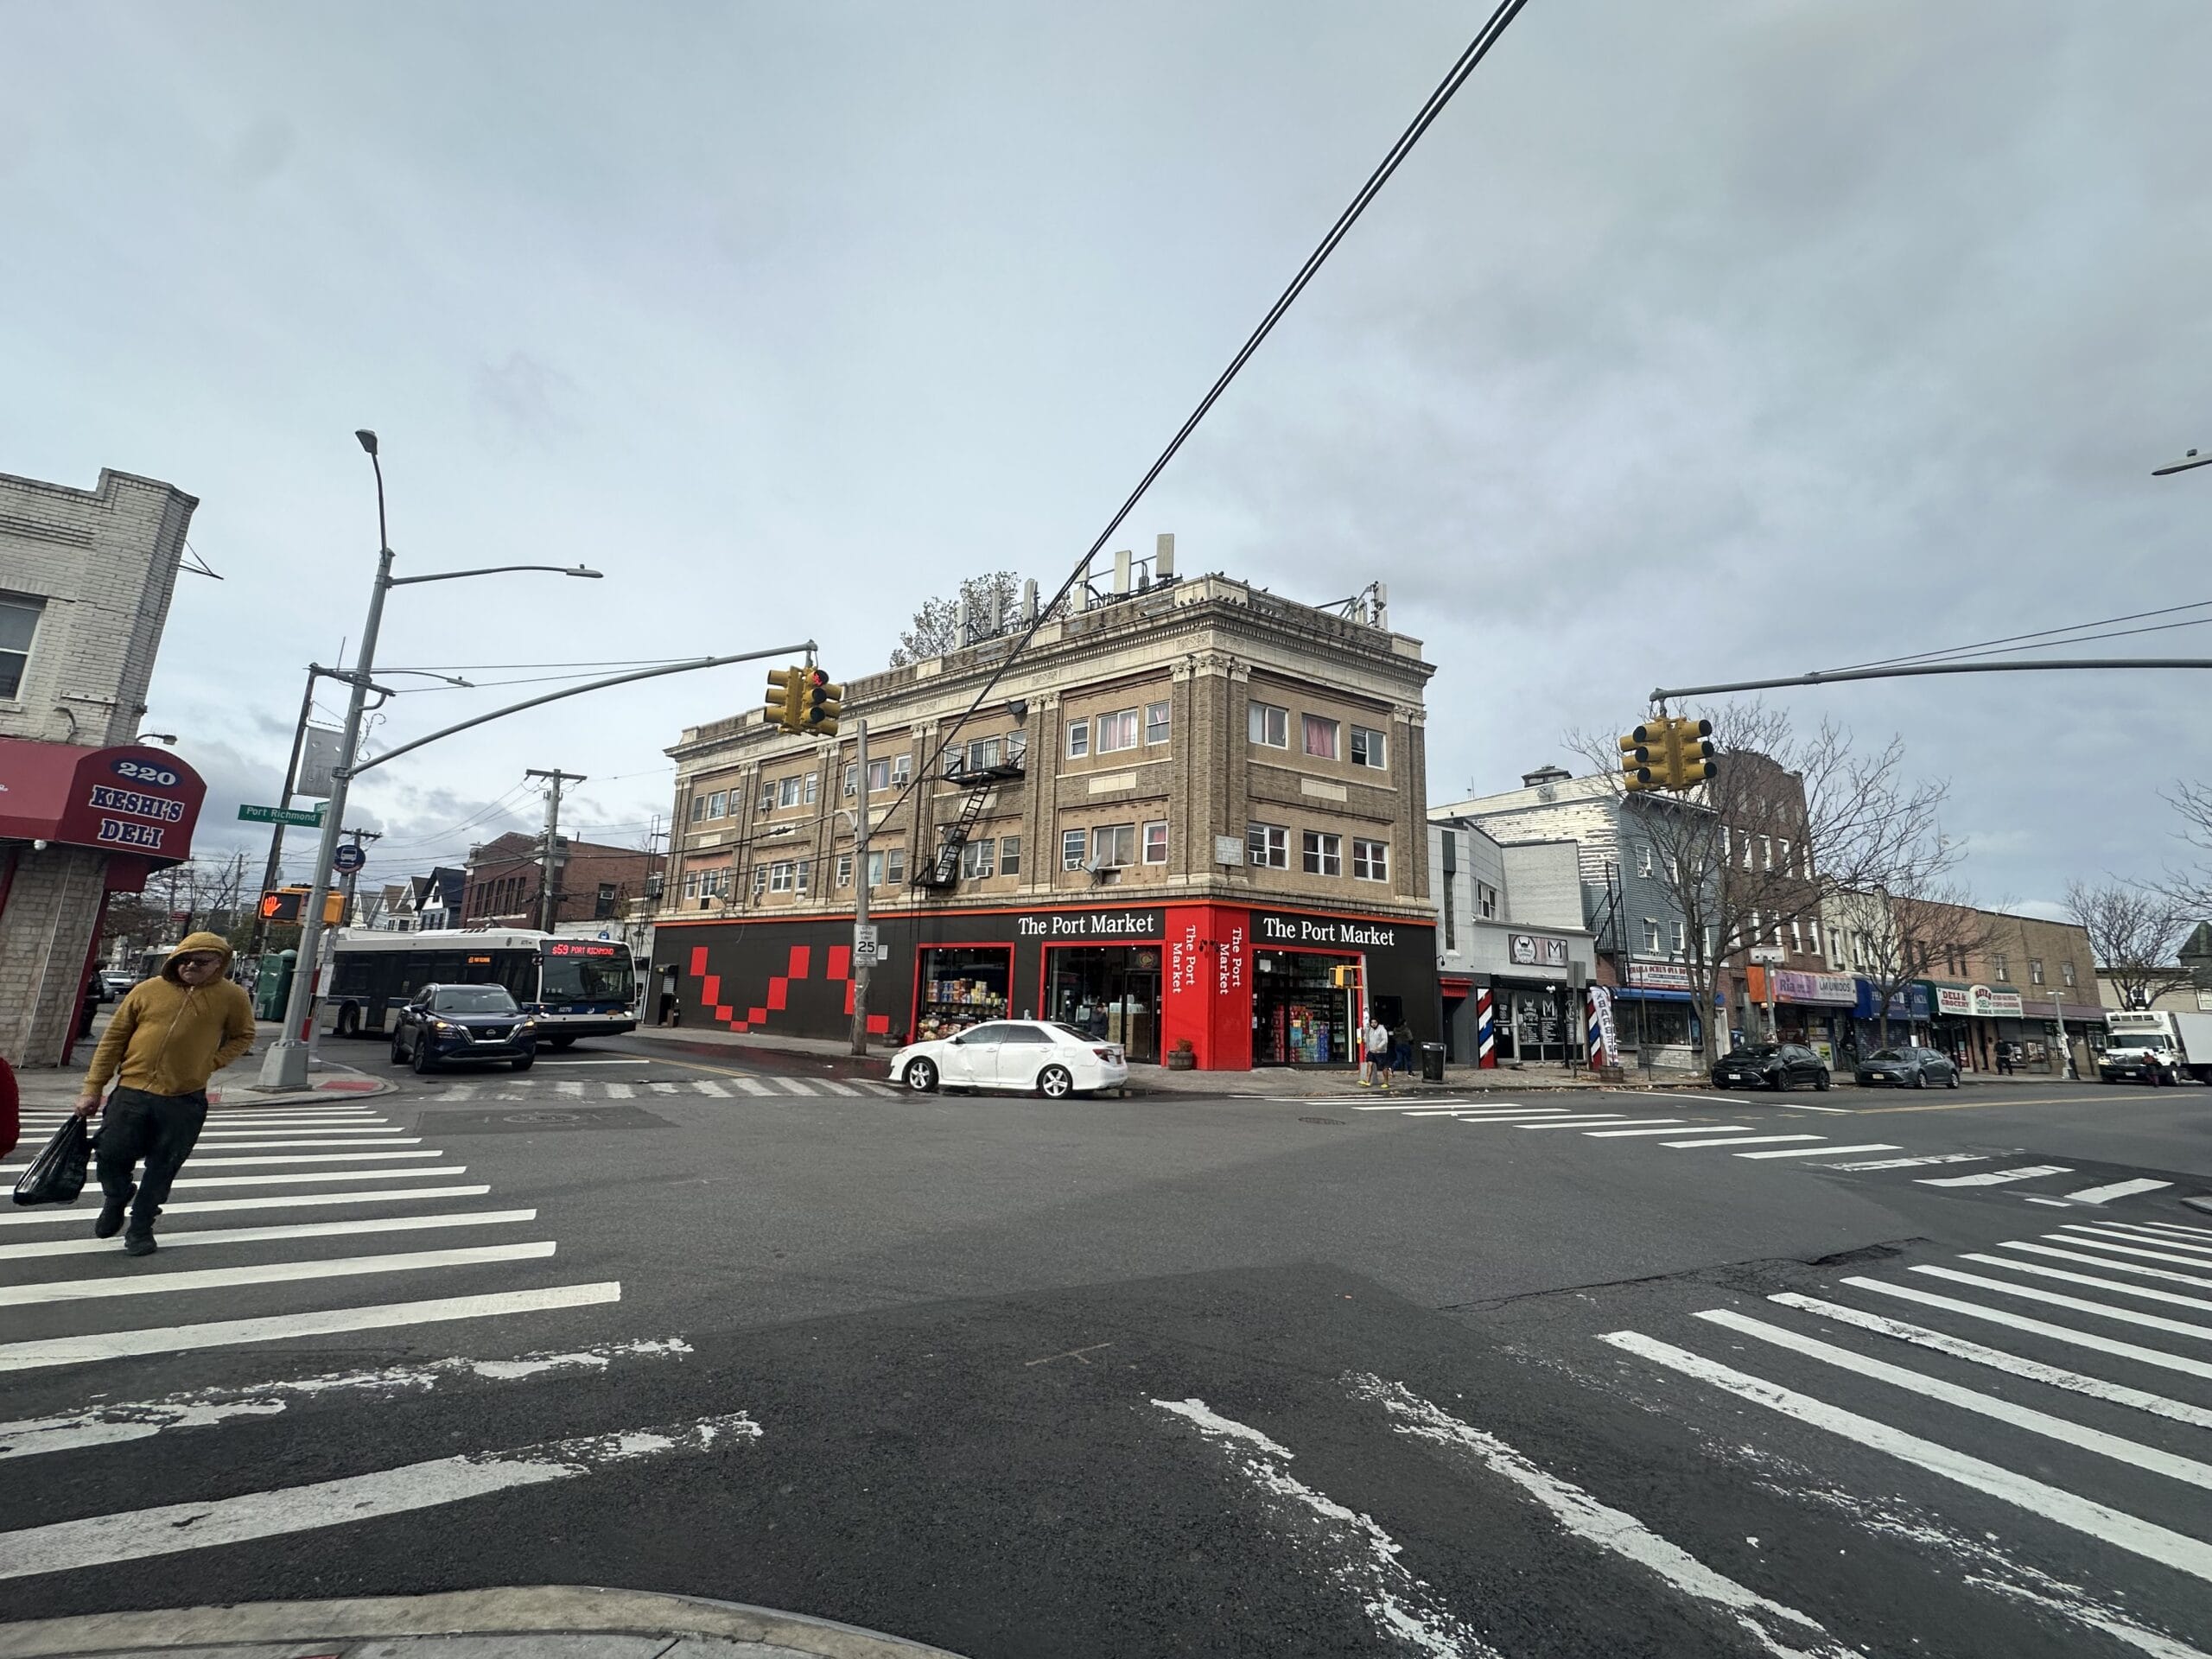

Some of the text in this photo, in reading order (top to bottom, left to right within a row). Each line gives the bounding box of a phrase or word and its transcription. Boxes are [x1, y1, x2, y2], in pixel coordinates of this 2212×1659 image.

[117, 762, 176, 785] 220
[88, 785, 185, 822] KESHI'S
[246, 806, 317, 822] Port Richmond
[97, 817, 164, 849] DELI
[1018, 912, 1154, 934] The Port Market
[1263, 918, 1395, 946] The Port Market
[571, 946, 585, 955] PORT
[587, 947, 614, 957] RICHMOND
[857, 941, 875, 953] 25
[1185, 925, 1197, 986] The Port
[1232, 927, 1243, 988] The Port
[1173, 943, 1183, 994] Market
[1219, 944, 1230, 995] Market
[1780, 976, 1796, 993] Ria
[1829, 982, 1850, 992] UNIDOS
[1942, 991, 1961, 1000] DELI
[1942, 999, 1969, 1008] GROCERY
